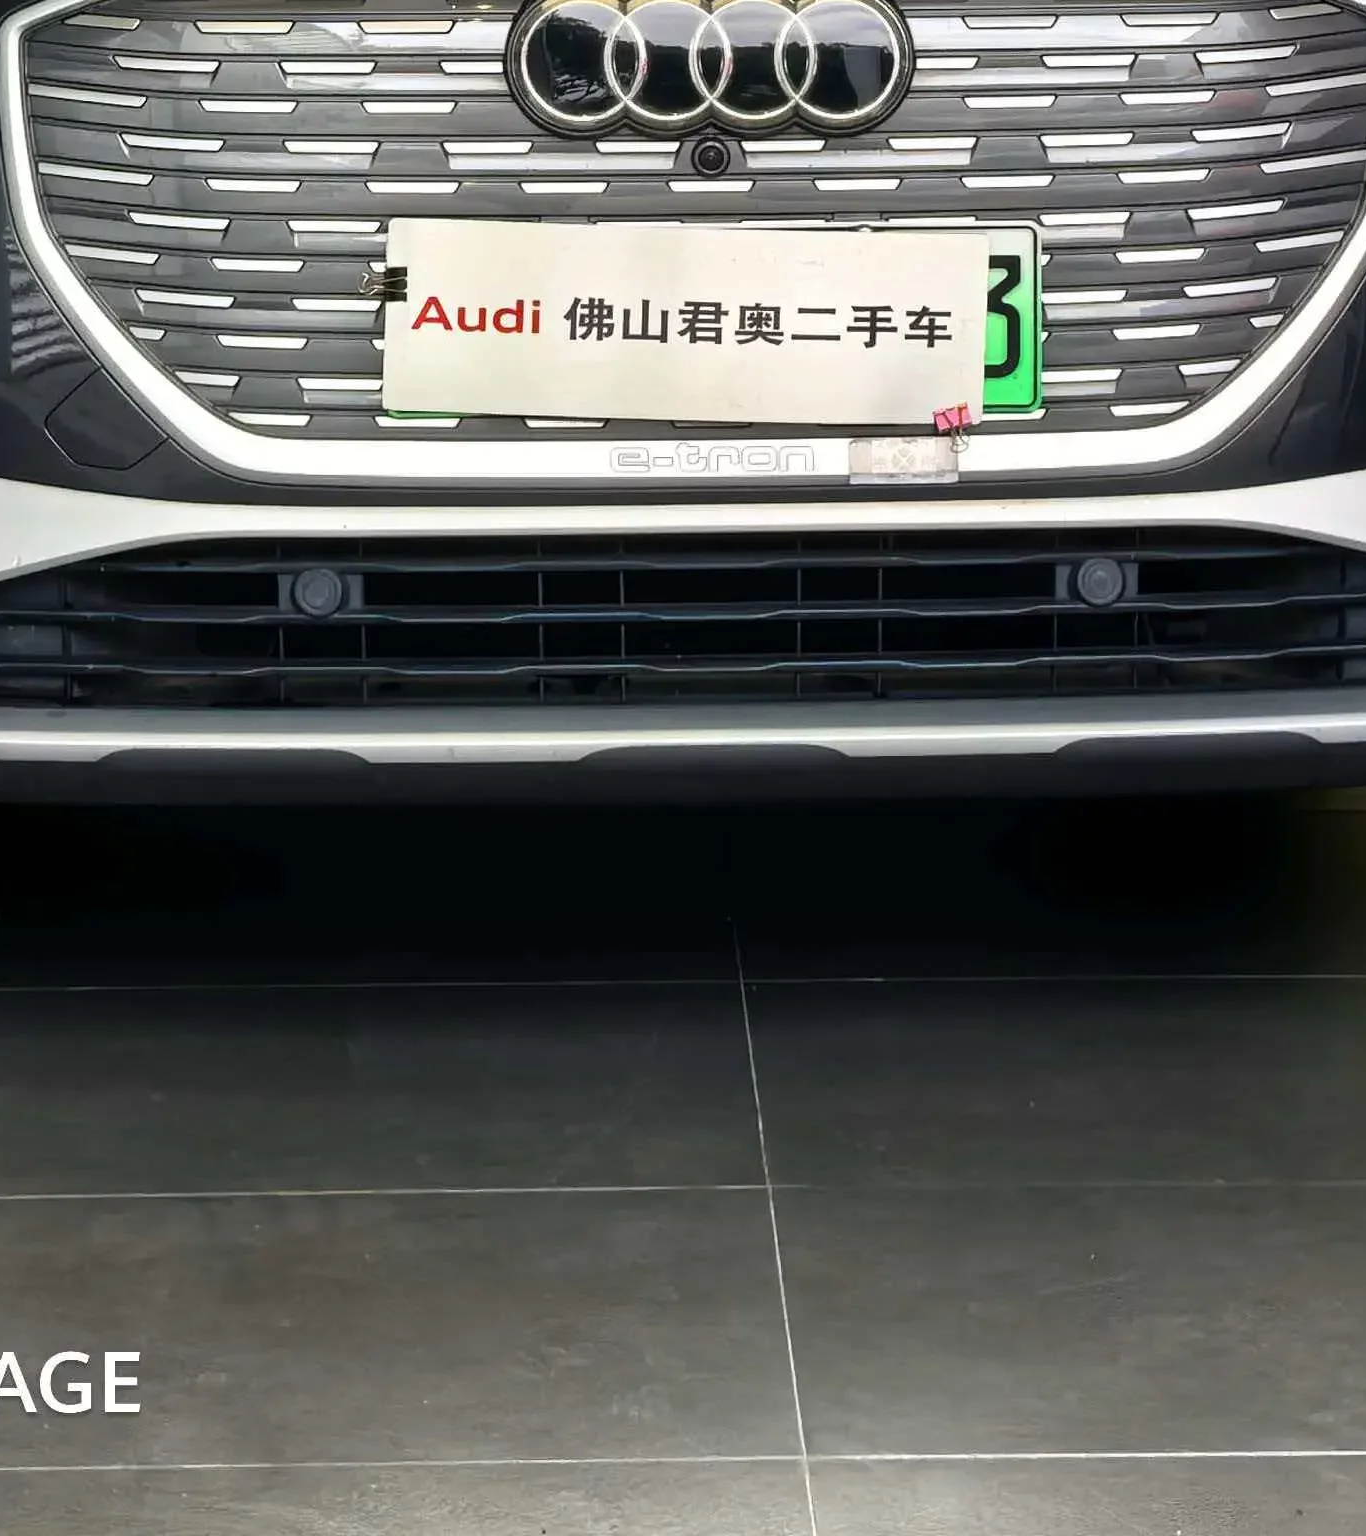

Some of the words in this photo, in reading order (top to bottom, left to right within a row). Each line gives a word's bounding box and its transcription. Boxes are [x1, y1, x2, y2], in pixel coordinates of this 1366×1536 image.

[411, 296, 542, 335] Audi
[563, 295, 953, 349] 佛山君奥二手车
[609, 441, 817, 473] e-tron
